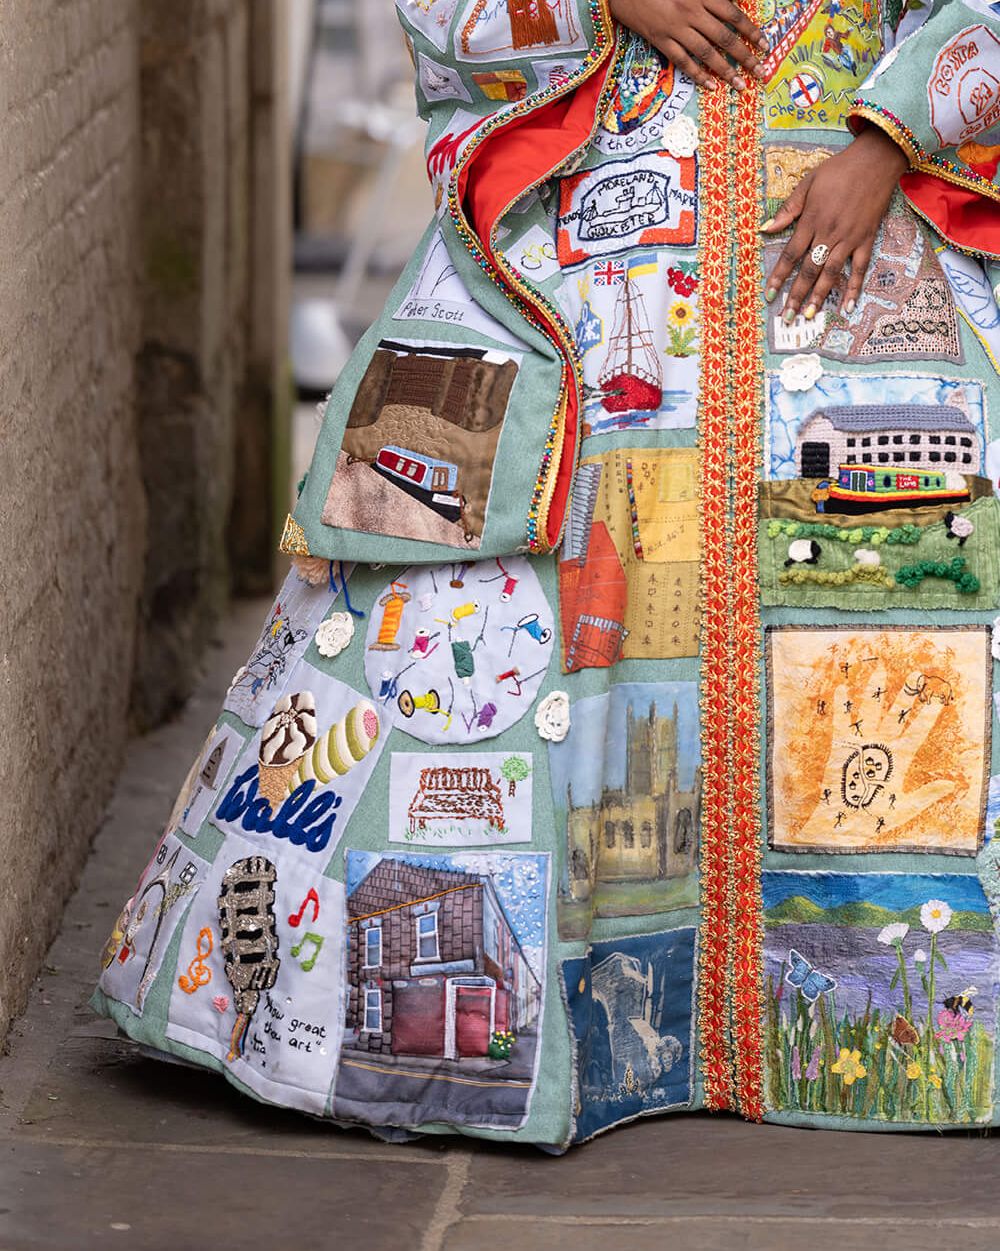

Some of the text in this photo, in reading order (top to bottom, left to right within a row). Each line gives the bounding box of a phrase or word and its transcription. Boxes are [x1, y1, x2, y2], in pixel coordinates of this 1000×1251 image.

[607, 135, 637, 150] the
[639, 89, 688, 145] Severn
[768, 101, 829, 123] cheese
[597, 173, 656, 196] MORELAND
[433, 302, 464, 321] Scott
[287, 1019, 326, 1038] great
